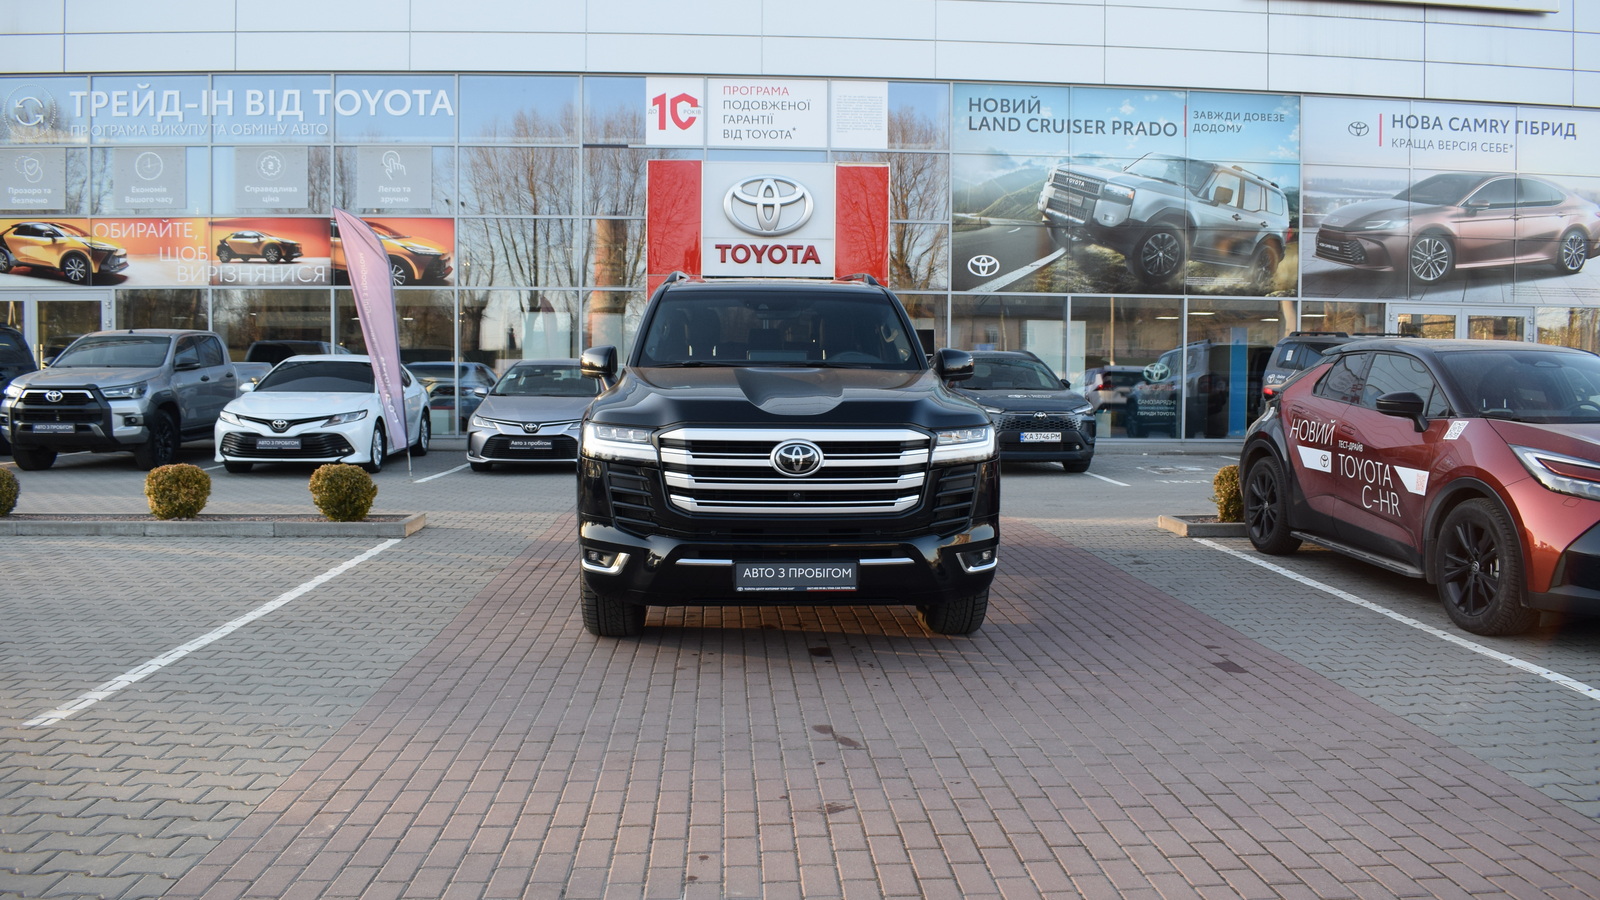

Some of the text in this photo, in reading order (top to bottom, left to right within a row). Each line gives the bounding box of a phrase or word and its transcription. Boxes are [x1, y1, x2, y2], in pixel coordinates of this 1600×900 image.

[723, 86, 789, 96] ПРОГРАМА
[70, 83, 454, 122] ТРЕЙД-ІН ВІД TOYOTA
[723, 99, 811, 112] ПОДОВЖЕНОЇ
[968, 95, 1041, 114] НОВИЙ
[652, 92, 698, 130] 10
[723, 113, 774, 125] ГАРАНТІЇ
[1193, 110, 1285, 123] ЗАВЖДИ ДОВЕЗЕ
[70, 123, 329, 137] ПРОГРАМА ВИКУПУ ТА ОБМІНУ АВТО
[968, 116, 1178, 137] LAND CRUISER PRADO
[1192, 123, 1242, 135] ДОДОМУ
[1392, 114, 1577, 140] НОВА CAMRY ГІБРИД
[723, 129, 743, 141] ВІД
[1392, 138, 1434, 150] КРАЩА
[1438, 140, 1478, 151] ВЕРСІЯ
[1066, 178, 1085, 186] TOYOTA
[159, 246, 208, 265] ЩОБ
[715, 244, 821, 265] TOYOTA
[177, 265, 326, 284] ВИРІЗНЯТИСЯ
[1289, 419, 1336, 446] НОВИЙ
[1338, 440, 1363, 452] ТЕСТ-ДРАЙВ
[1338, 453, 1393, 488] TOYOTA
[1362, 485, 1401, 517] C-HR
[743, 568, 852, 578] АВТО З ПРОБІГОМ
